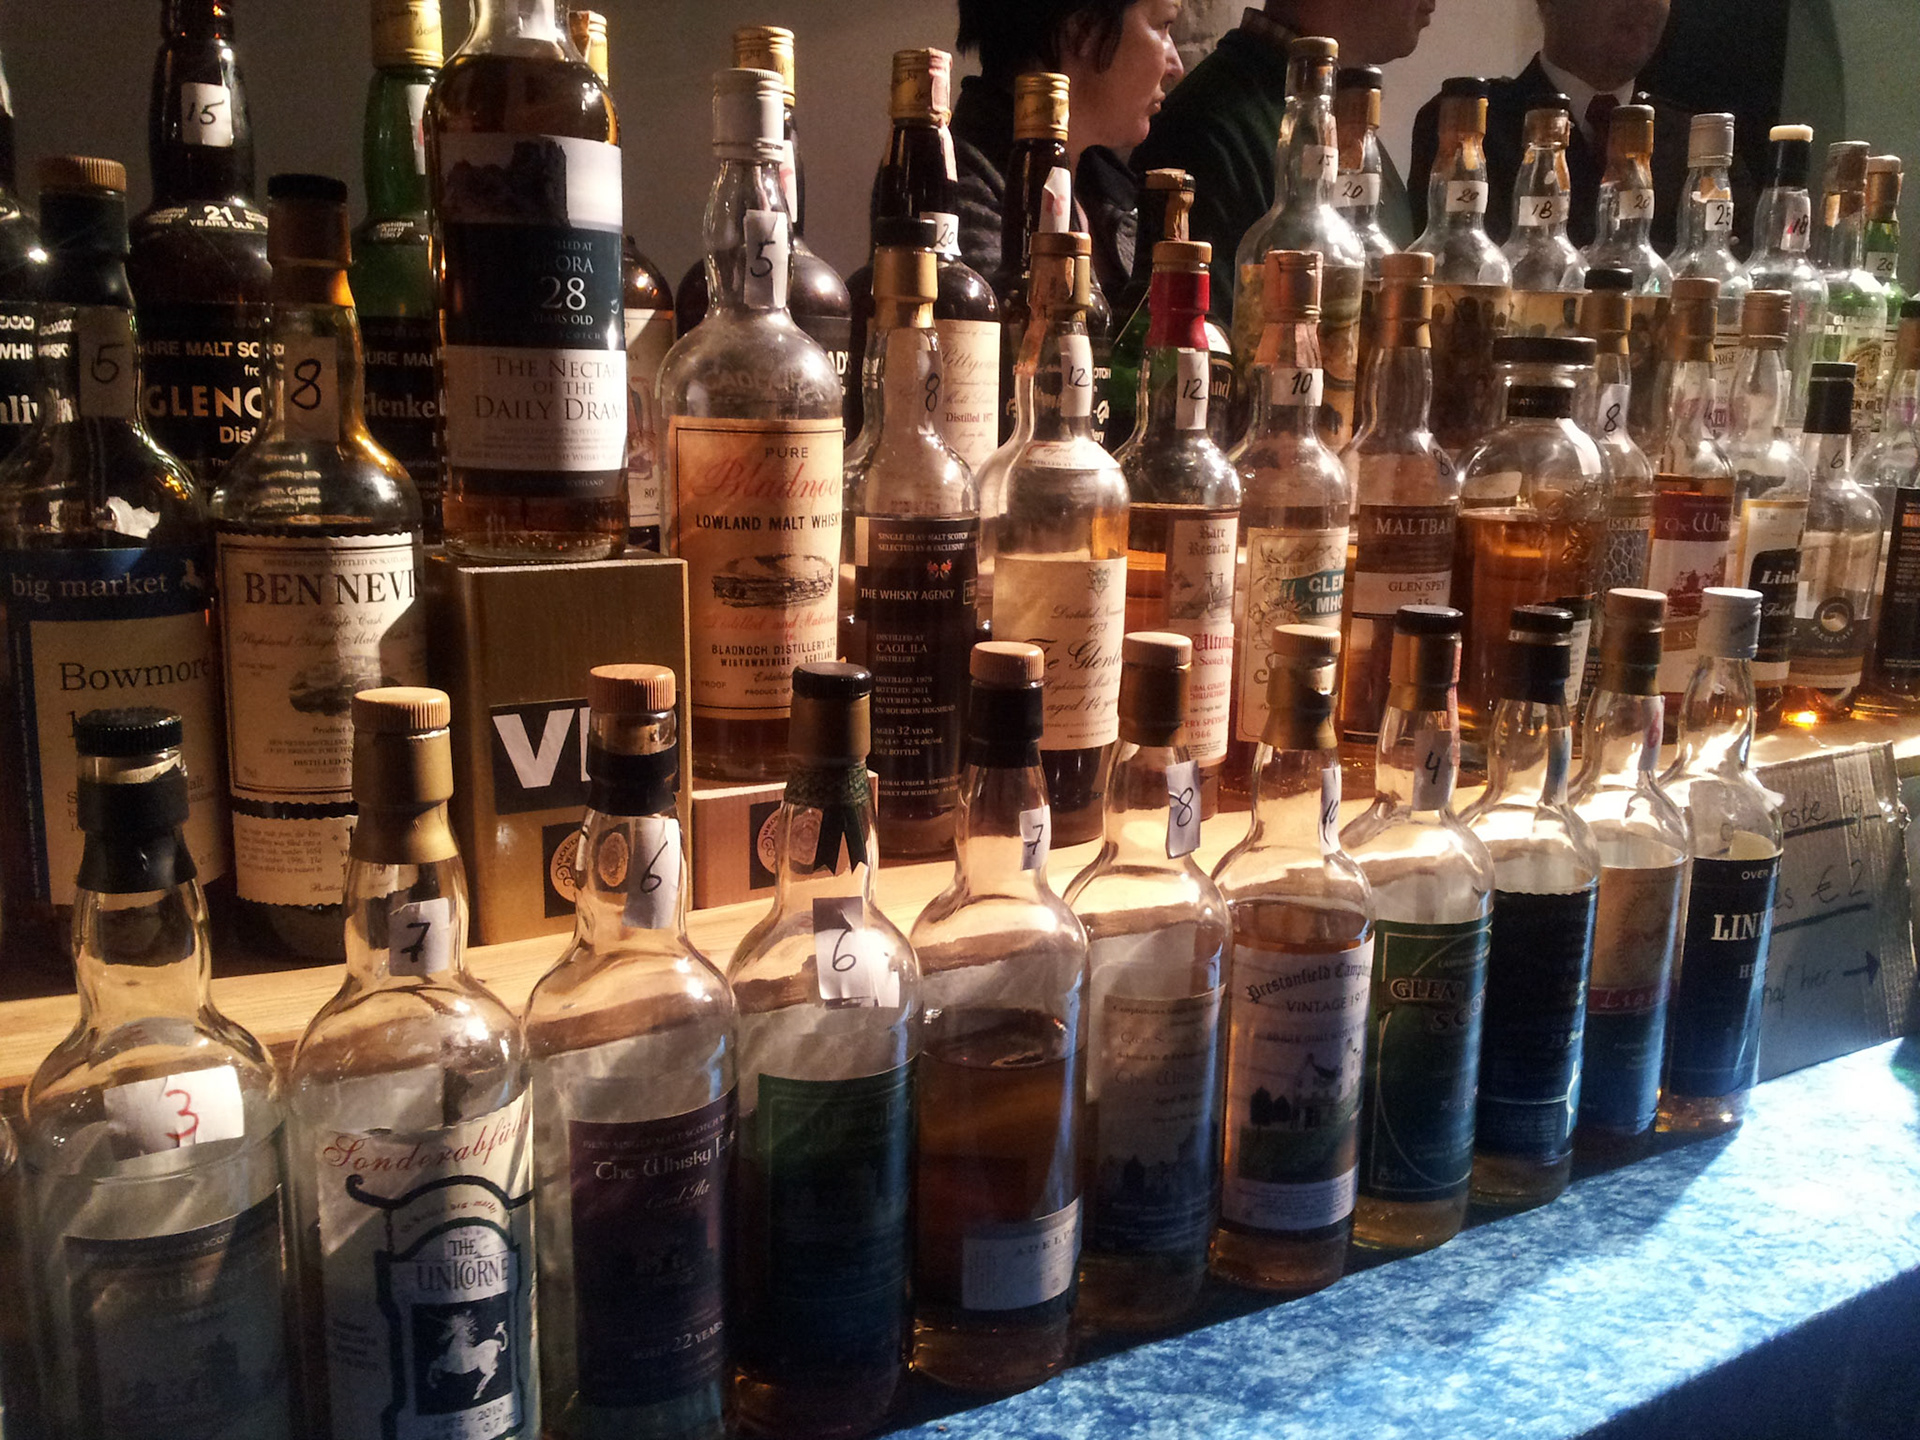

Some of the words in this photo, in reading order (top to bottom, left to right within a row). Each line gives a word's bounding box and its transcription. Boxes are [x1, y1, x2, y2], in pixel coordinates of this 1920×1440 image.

[186, 102, 219, 126] 15
[1343, 180, 1364, 200] 20
[203, 204, 234, 221] 21
[1714, 203, 1732, 228] 25
[189, 218, 227, 229] YEARS
[230, 219, 256, 231] OLD
[750, 240, 776, 278] 5
[1876, 256, 1894, 272] 20
[541, 276, 588, 311] 28
[570, 314, 594, 326] OLD
[185, 341, 234, 358] MALT
[91, 343, 124, 384] 5
[496, 357, 542, 376] THE
[291, 358, 322, 411] 8
[532, 381, 556, 396] OF
[563, 381, 595, 396] THE
[1067, 366, 1092, 388] 12
[1291, 370, 1314, 396] 10
[925, 372, 942, 413] 8
[1182, 379, 1208, 402] 12
[475, 395, 556, 421] DAILY
[1603, 402, 1621, 433] 8
[764, 446, 810, 459] PURE
[1829, 450, 1846, 469] 6
[696, 513, 762, 531] LOWLAND
[768, 516, 806, 531] MALT
[11, 572, 50, 604] big
[60, 572, 168, 598] market
[245, 571, 325, 606] BEN
[860, 587, 878, 601] THE
[879, 587, 920, 601] WHISKY
[921, 587, 958, 601] AGENCY
[1387, 581, 1422, 592] GLEN
[711, 643, 769, 658] BLADNOCH
[773, 640, 827, 658] DISTILLERY
[876, 643, 908, 654] CAOL
[910, 643, 929, 654] ILA
[58, 655, 211, 692] Bowmore
[1423, 751, 1443, 786] 4
[1167, 785, 1195, 828] 8
[640, 839, 671, 894] 6
[1741, 869, 1769, 881] OVER
[401, 920, 432, 964] 7
[832, 926, 857, 973] 6
[1389, 976, 1459, 1002] GLEN
[1286, 995, 1348, 1014] VINTAGE
[165, 1089, 199, 1138] 3
[592, 1160, 636, 1181] The
[642, 1147, 712, 1178] Whisky
[448, 1238, 479, 1257] THE
[671, 1332, 693, 1353] 22
